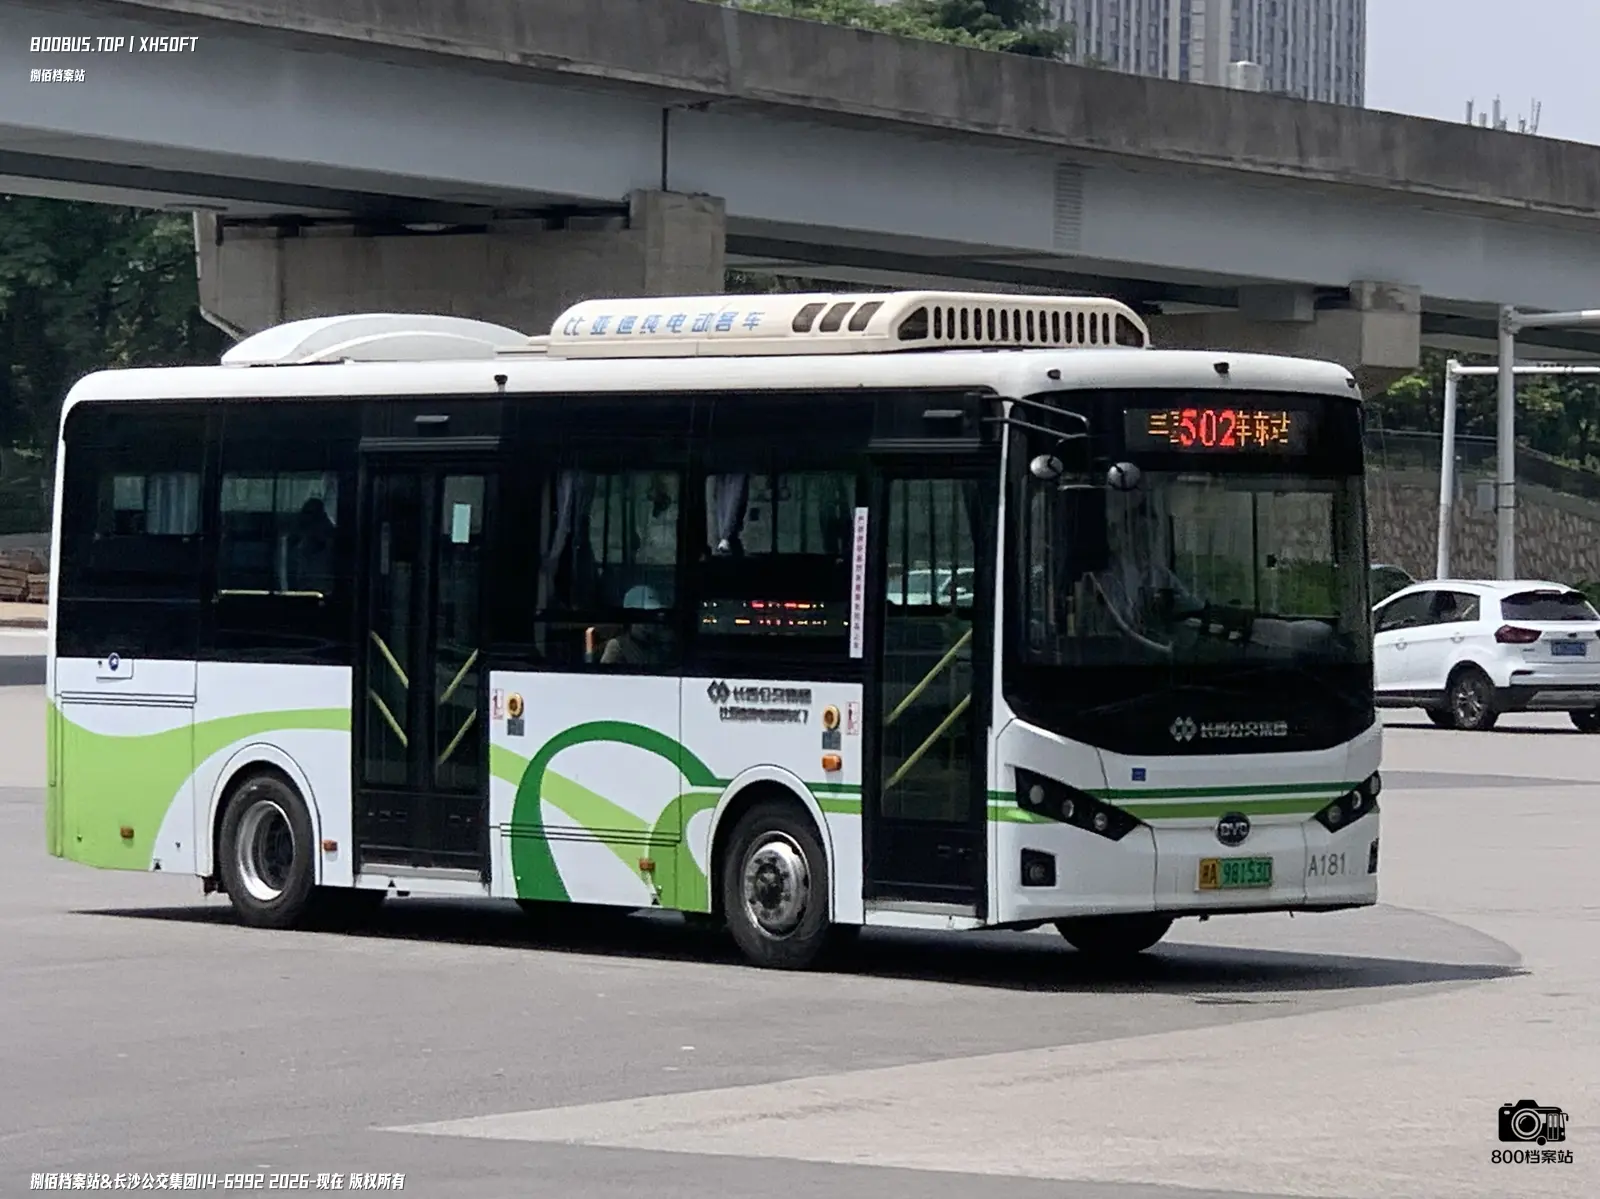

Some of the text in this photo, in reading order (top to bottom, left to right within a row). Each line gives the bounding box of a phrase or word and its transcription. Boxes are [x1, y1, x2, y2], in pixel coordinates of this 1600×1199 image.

[562, 311, 767, 337] 比亚迪纯电动客车
[1180, 407, 1236, 447] 502
[1307, 851, 1347, 877] A181
